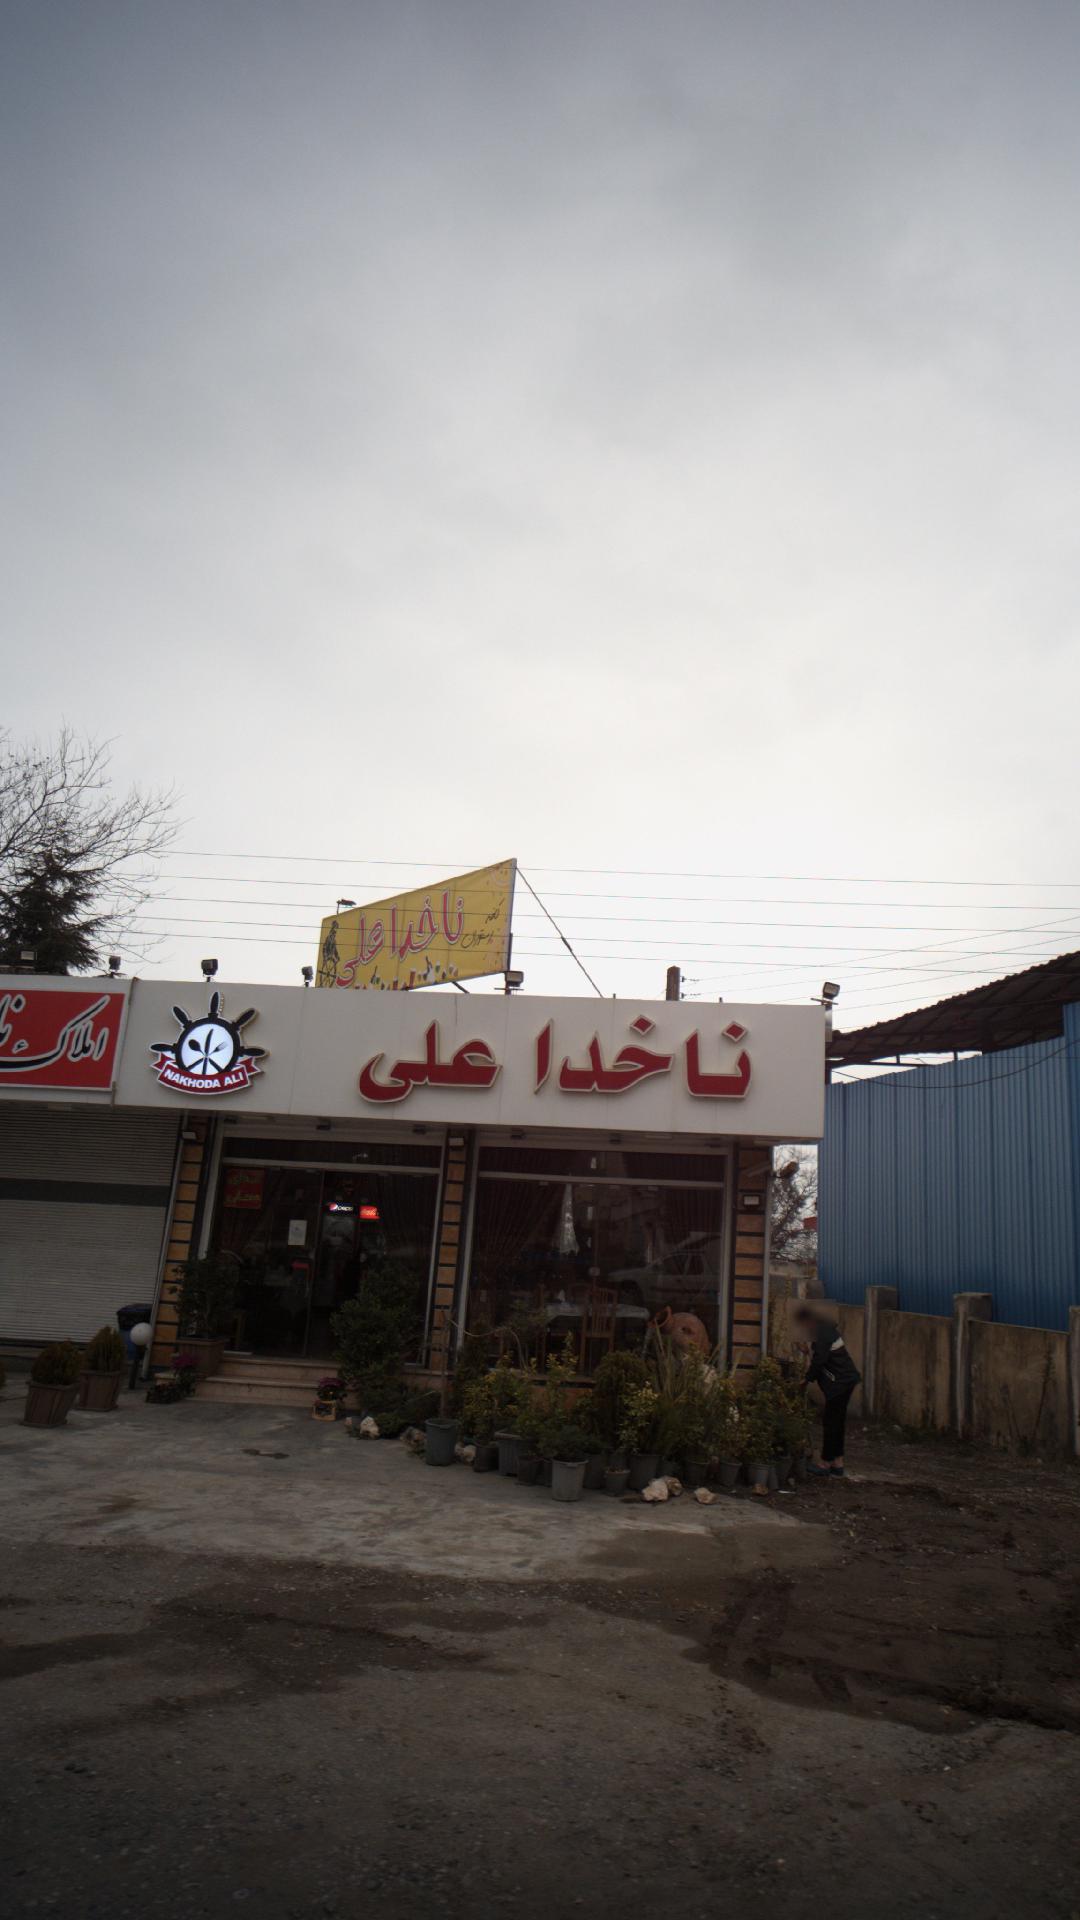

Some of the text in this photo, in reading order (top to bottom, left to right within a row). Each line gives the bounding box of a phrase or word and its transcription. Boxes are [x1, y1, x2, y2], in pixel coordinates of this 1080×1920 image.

[335, 889, 464, 988] ناخدا علی
[163, 1069, 244, 1089] NAKHODA ALI
[358, 1014, 752, 1103] ناخدا علی
